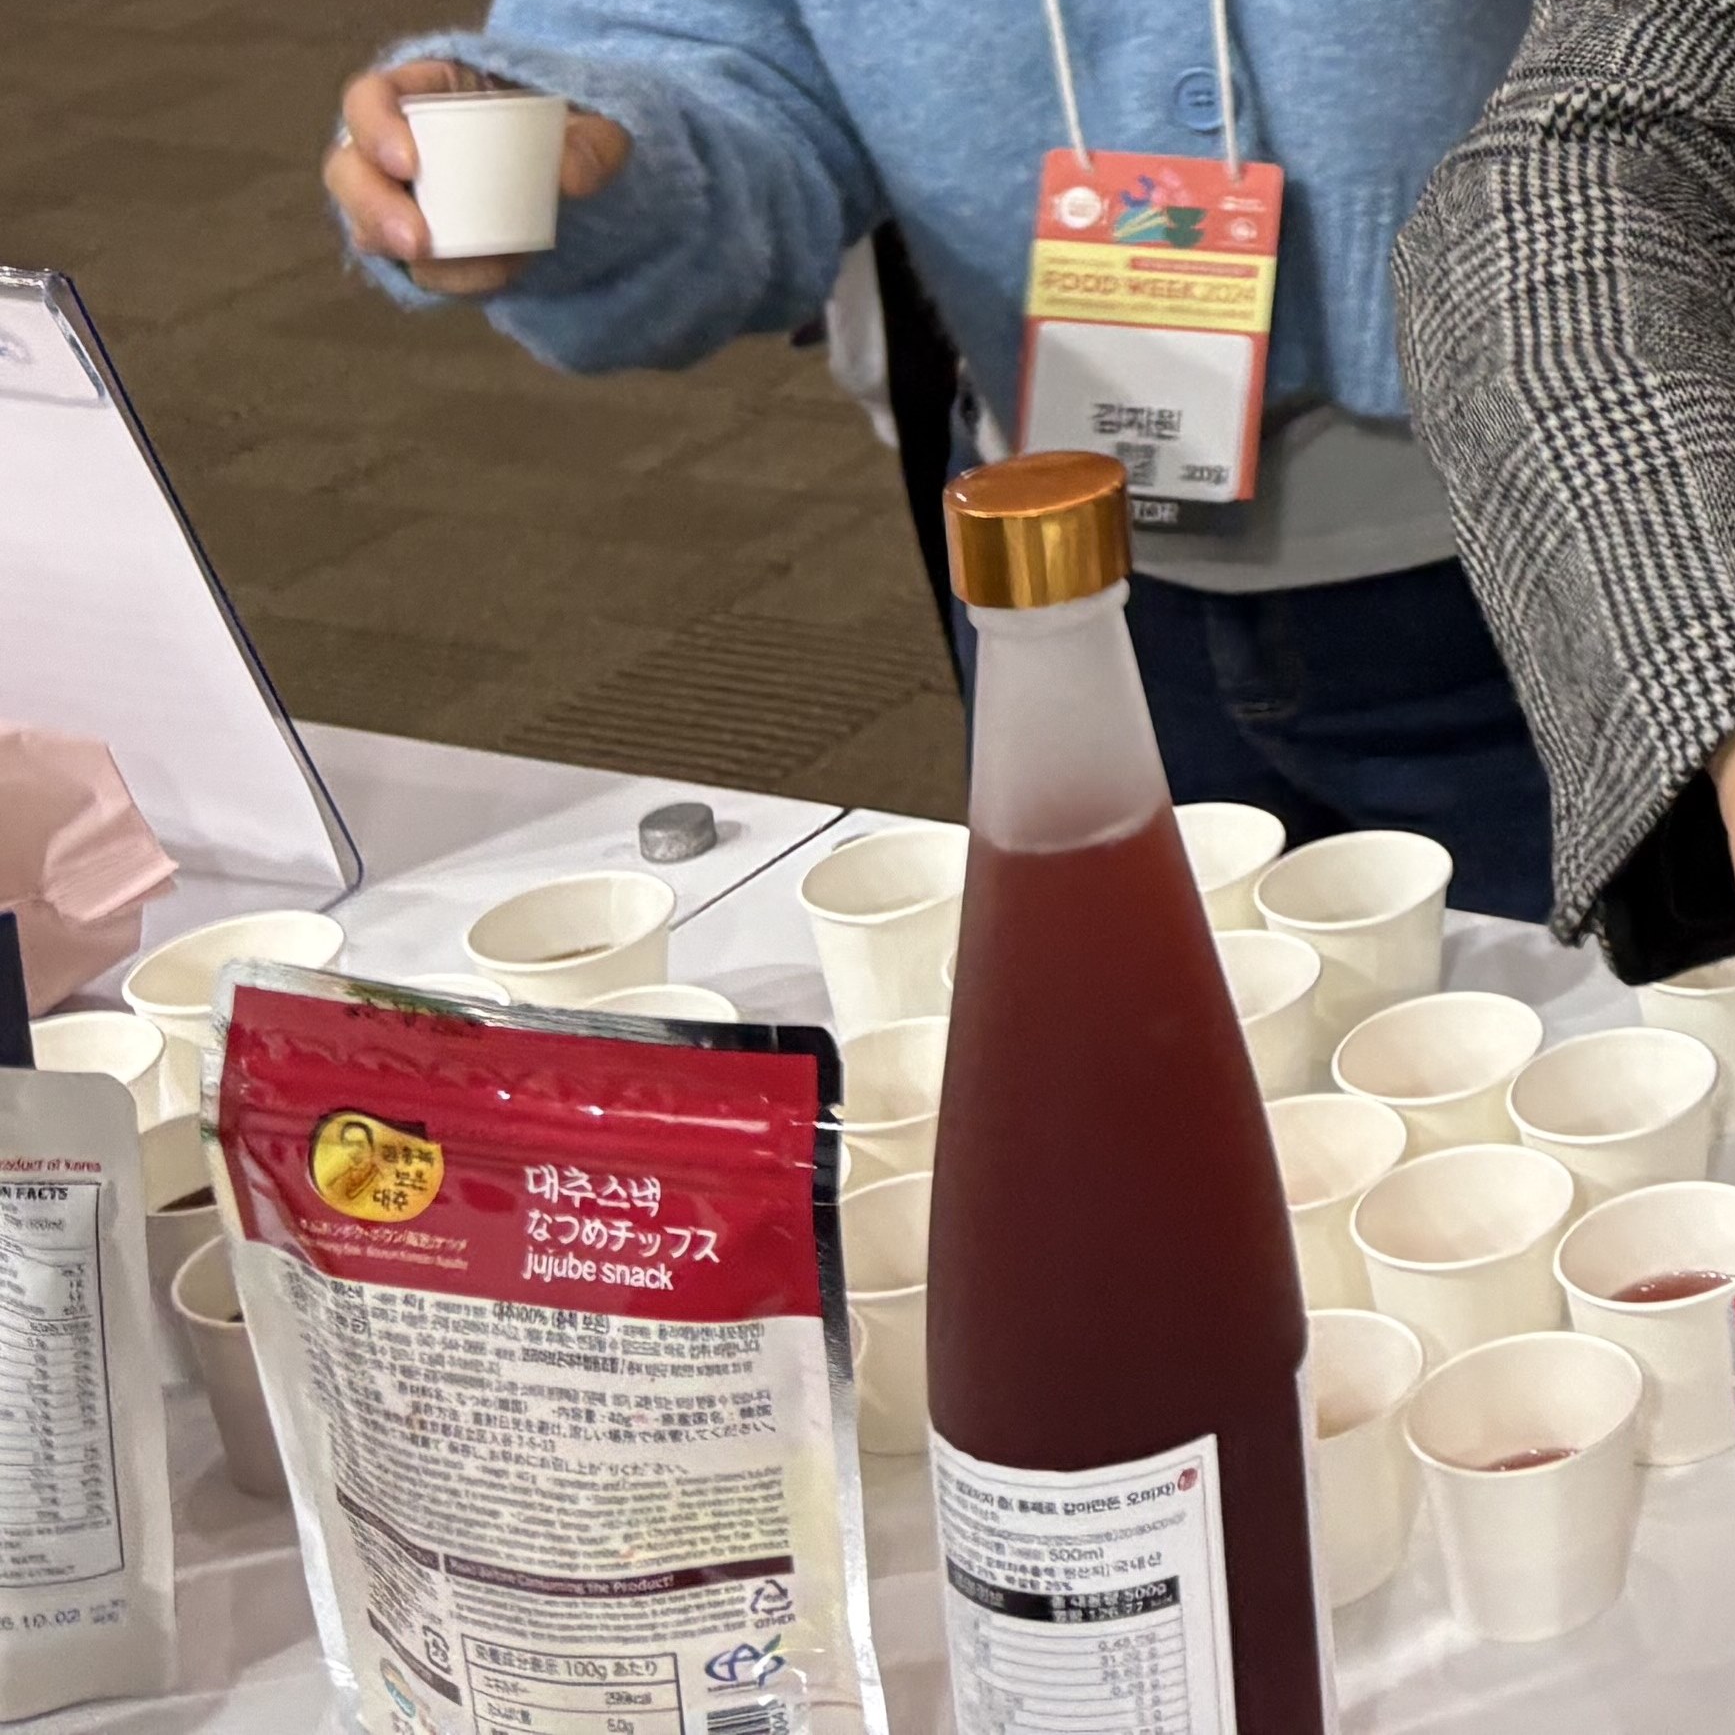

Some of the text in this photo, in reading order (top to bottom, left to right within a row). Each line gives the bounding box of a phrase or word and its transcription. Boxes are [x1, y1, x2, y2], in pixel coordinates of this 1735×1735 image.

[16, 1186, 69, 1201] FACTS
[372, 1188, 409, 1211] 대추
[523, 1164, 662, 1218] 대추스낵
[524, 1208, 721, 1264] なつめチップス
[521, 1247, 674, 1292] jujube snack
[562, 1659, 607, 1682] 100g
